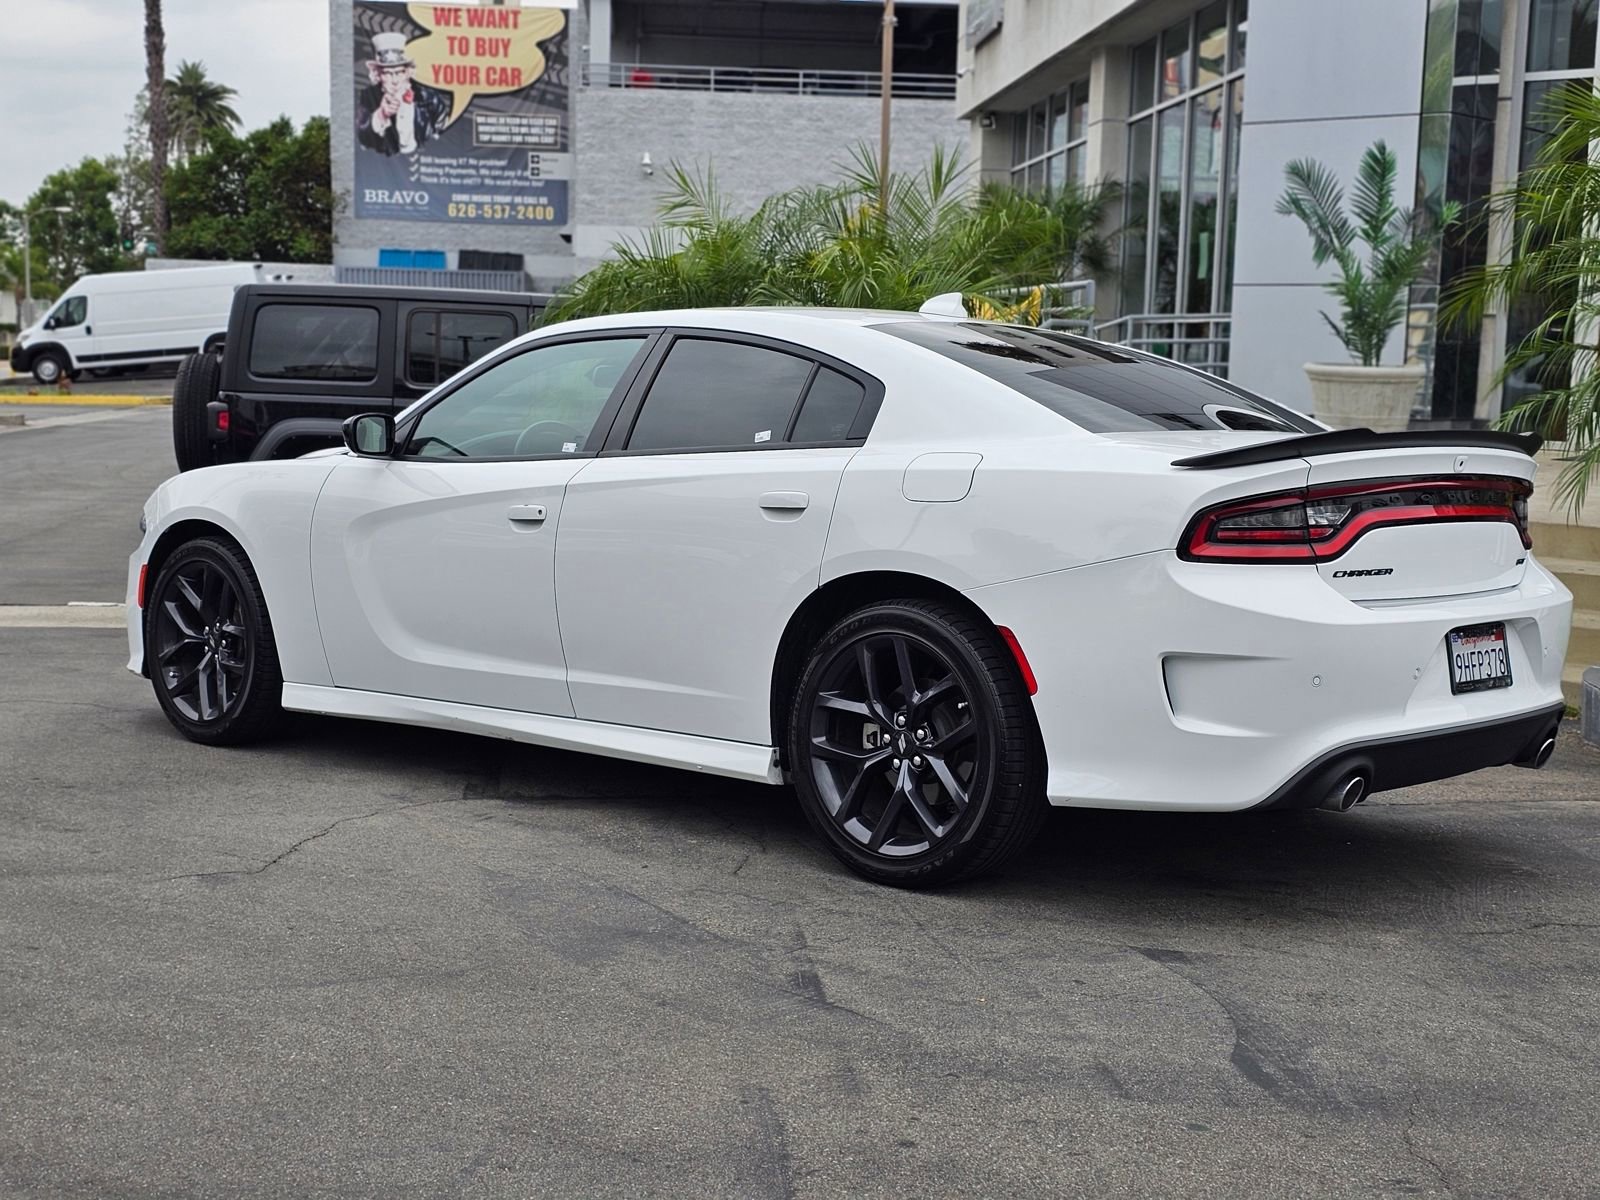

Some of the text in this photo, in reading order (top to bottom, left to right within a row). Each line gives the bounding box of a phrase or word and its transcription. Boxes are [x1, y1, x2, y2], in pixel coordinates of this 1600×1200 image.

[433, 7, 521, 29] WE WANT
[446, 36, 511, 58] TO BUY
[432, 64, 522, 87] YOUR CAR
[364, 189, 429, 205] BRAVO
[448, 202, 554, 220] 626-537-2400
[1332, 568, 1394, 578] CHARGER
[1455, 647, 1506, 682] 9HFP378
